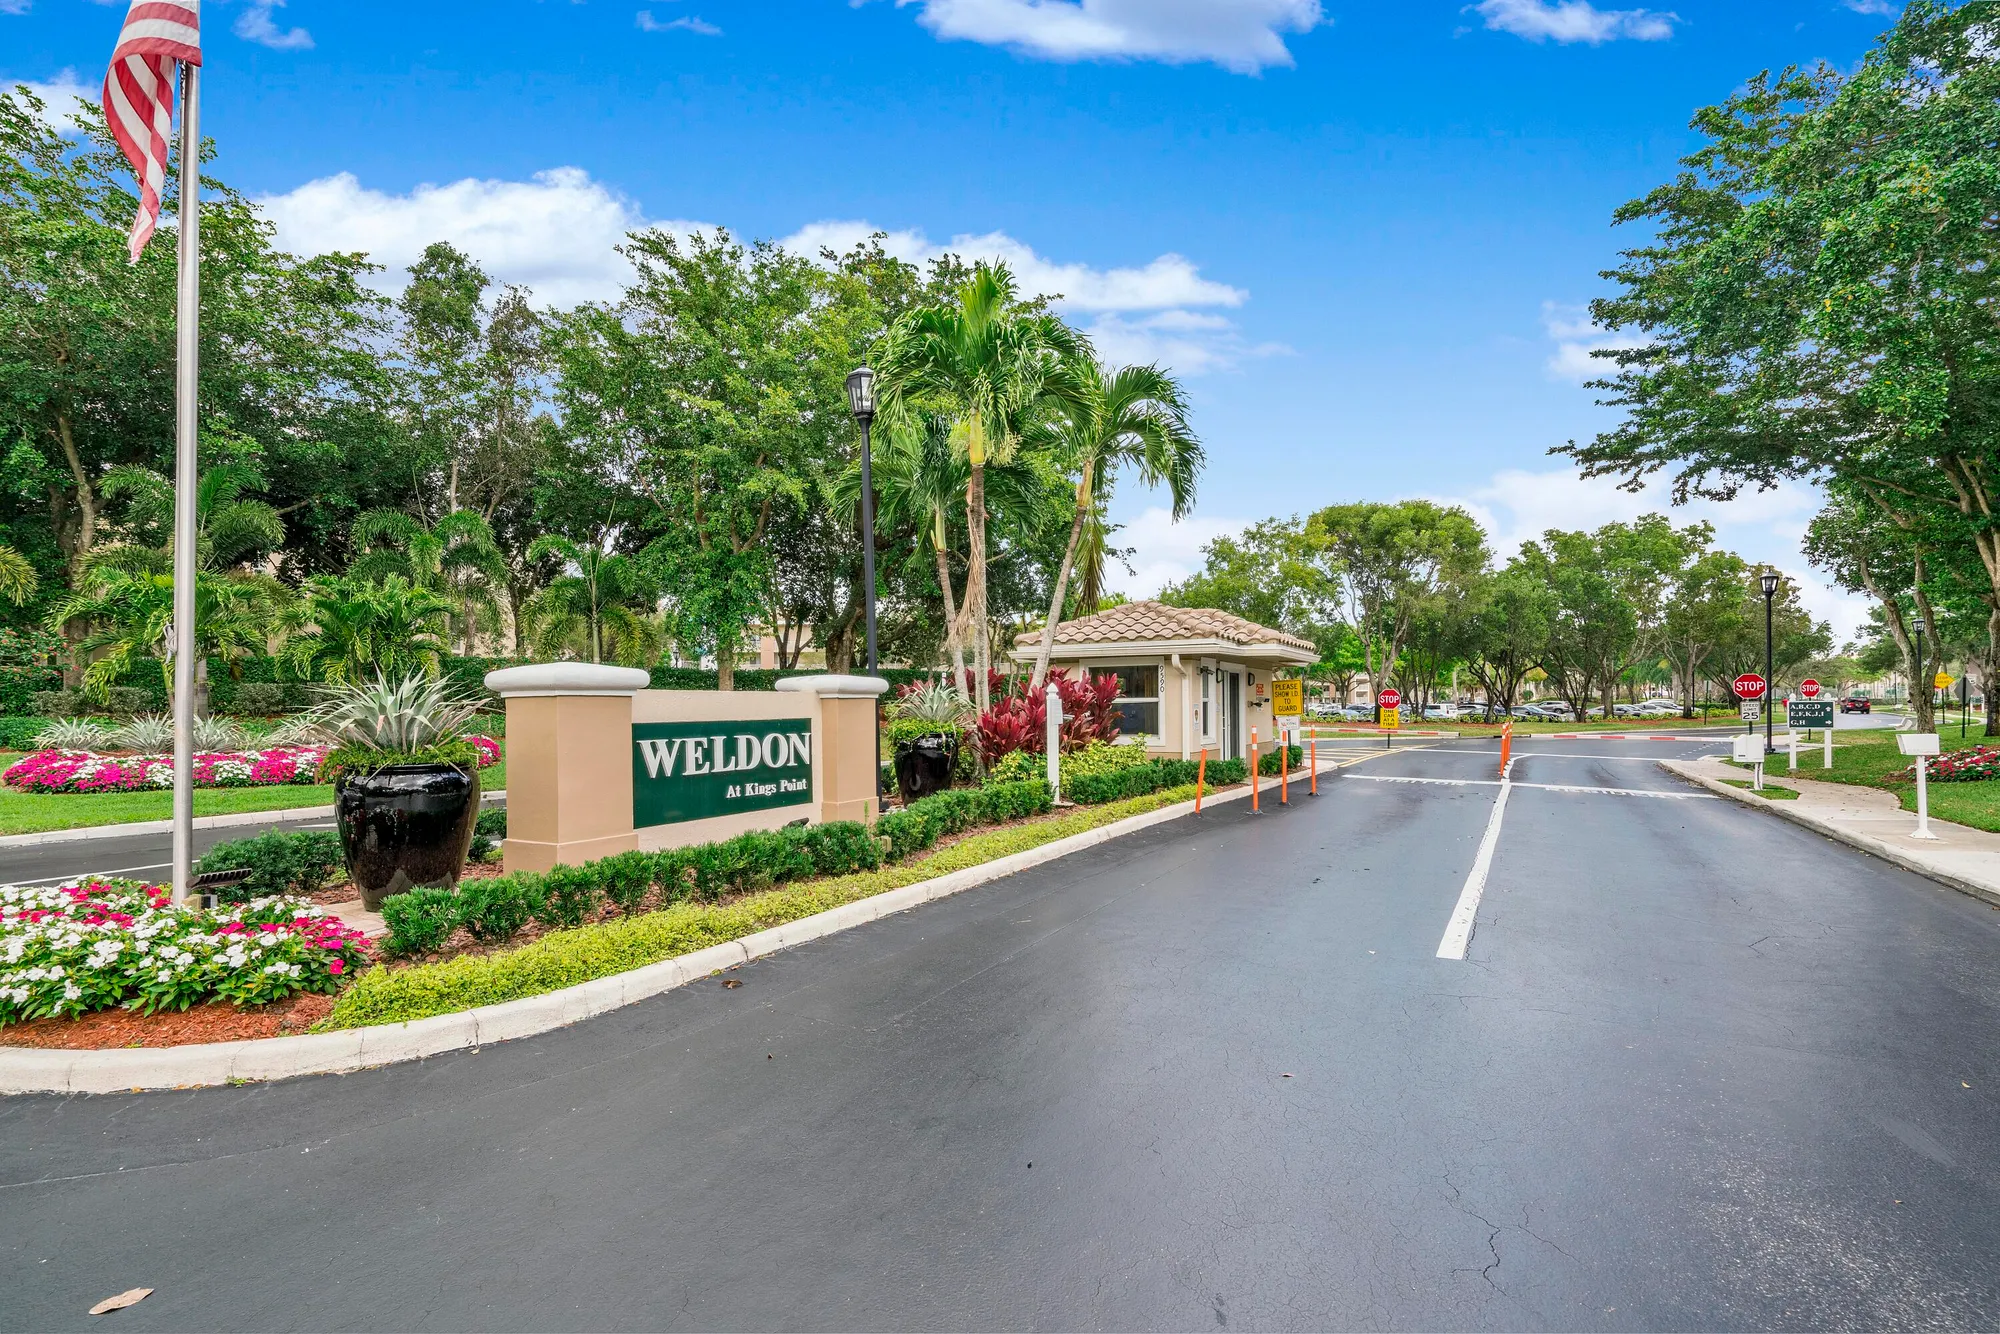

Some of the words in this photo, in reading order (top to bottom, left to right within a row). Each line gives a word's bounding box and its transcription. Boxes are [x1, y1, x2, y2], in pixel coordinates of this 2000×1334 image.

[1736, 681, 1764, 691] STOP
[1802, 684, 1818, 692] STOP
[1380, 695, 1400, 704] STOP
[1742, 712, 1758, 720] 25
[636, 732, 812, 779] WELDON
[726, 785, 741, 799] At
[744, 782, 777, 796] Kings
[780, 778, 808, 792] Point
